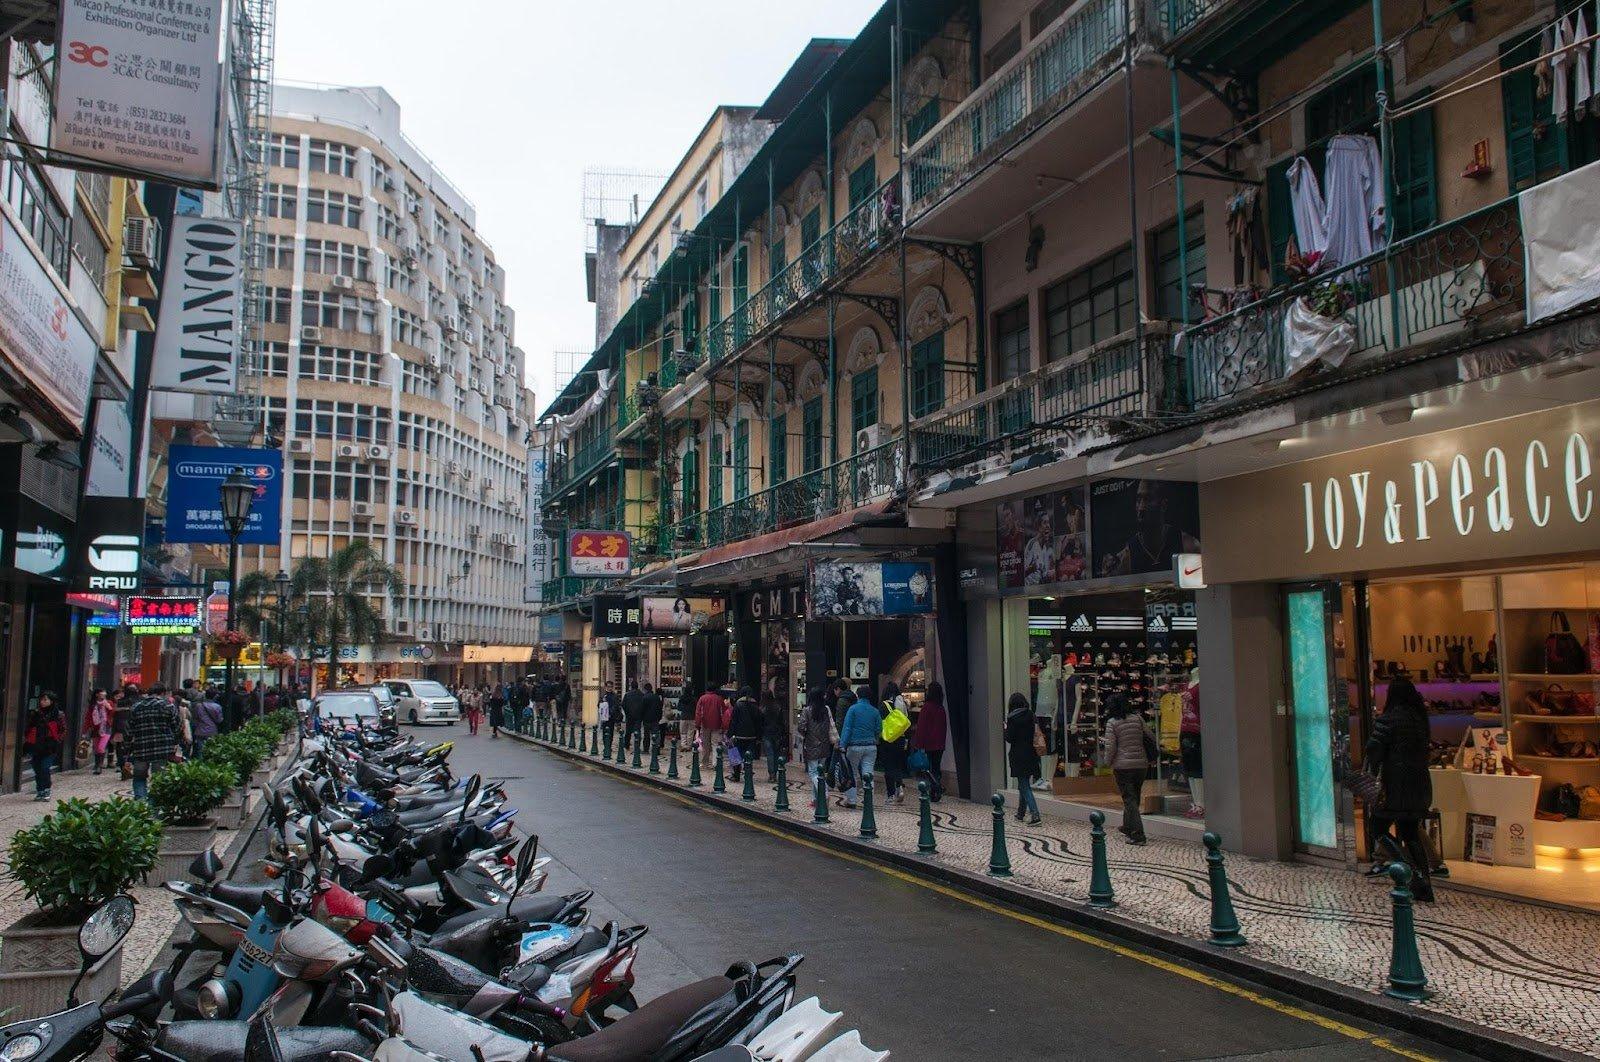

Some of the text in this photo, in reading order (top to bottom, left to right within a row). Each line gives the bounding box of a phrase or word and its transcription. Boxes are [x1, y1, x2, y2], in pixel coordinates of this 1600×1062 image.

[74, 0, 210, 34] Macao Professional Conference &
[85, 11, 197, 43] Exhibition Organizer Ltd
[68, 41, 110, 68] 3C
[112, 63, 200, 92] 3C&C Consultancy
[77, 98, 94, 108] Tel
[149, 110, 168, 121] 2832
[180, 223, 236, 386] MANGO
[179, 464, 255, 477] mannins
[1303, 471, 1370, 554] JOY
[1384, 480, 1404, 544] &
[575, 535, 625, 558] 大方
[89, 576, 138, 590] RAW
[607, 608, 640, 625] 時間
[1403, 634, 1423, 653] JOY
